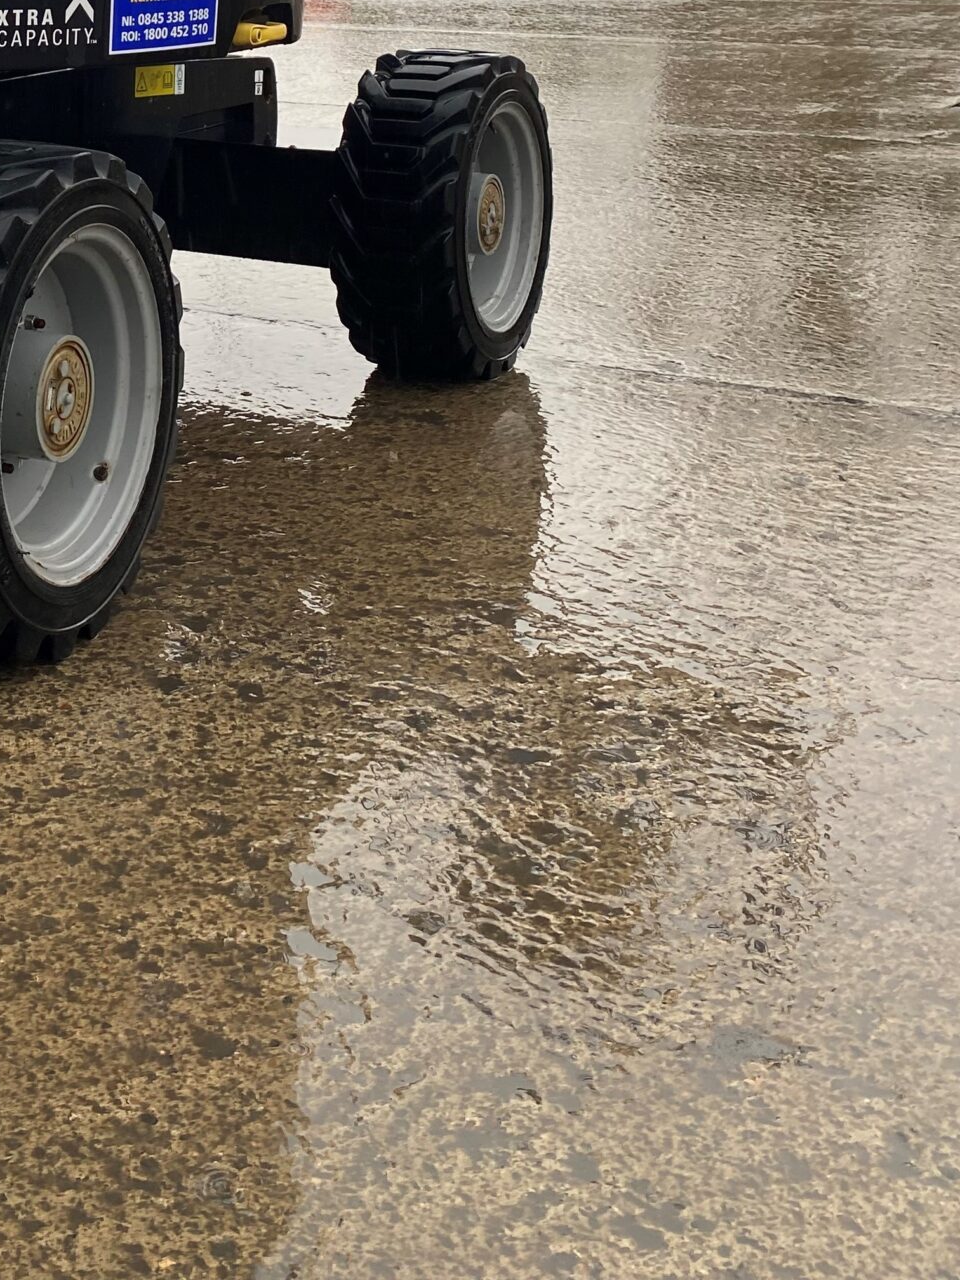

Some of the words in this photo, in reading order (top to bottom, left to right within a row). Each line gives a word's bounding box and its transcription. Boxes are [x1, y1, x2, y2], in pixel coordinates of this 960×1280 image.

[121, 16, 135, 27] NI:
[137, 12, 165, 26] 0845
[167, 10, 185, 23] 338
[188, 8, 209, 21] 1388
[121, 30, 141, 42] ROI:
[143, 27, 168, 41] 1800
[170, 25, 189, 38] 452
[191, 23, 208, 36] 510
